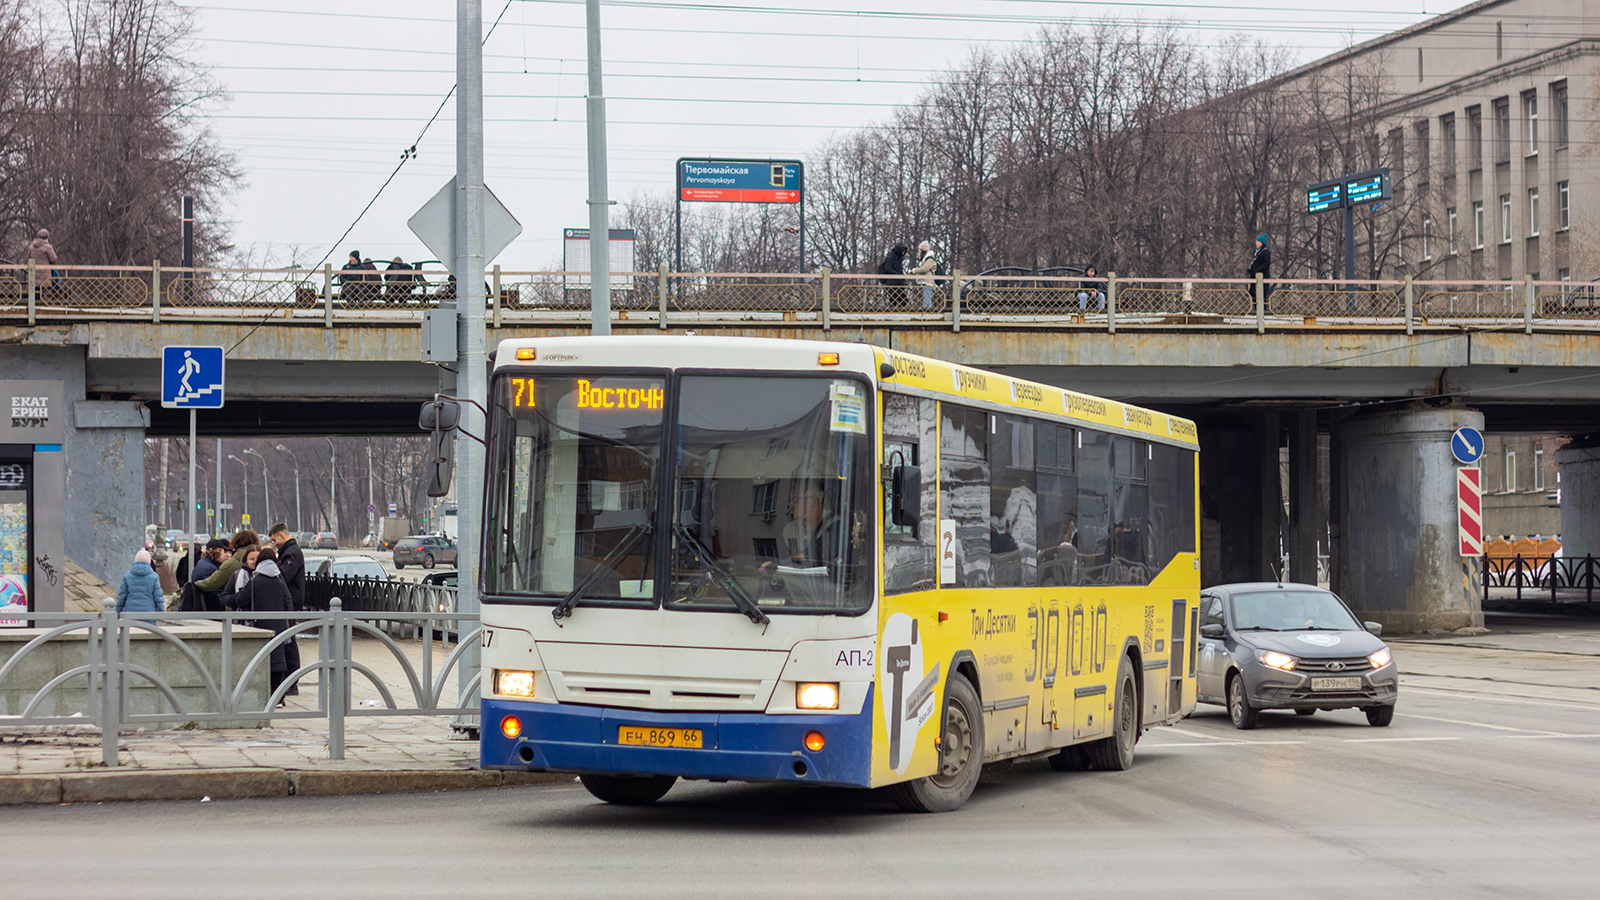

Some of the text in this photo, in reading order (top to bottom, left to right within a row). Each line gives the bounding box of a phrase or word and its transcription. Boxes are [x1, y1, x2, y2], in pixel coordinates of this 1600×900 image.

[685, 165, 749, 175] Первомайская
[686, 177, 736, 185] Pervomayskaya
[512, 378, 664, 409] 71 Восточн
[11, 396, 49, 407] ЕКАТ
[11, 407, 49, 418] ЕРИН
[11, 417, 49, 428] БУРГ
[971, 609, 1017, 641] Три Десятки
[835, 650, 874, 666] АП-2
[649, 730, 675, 745] 869
[683, 730, 698, 742] 66
